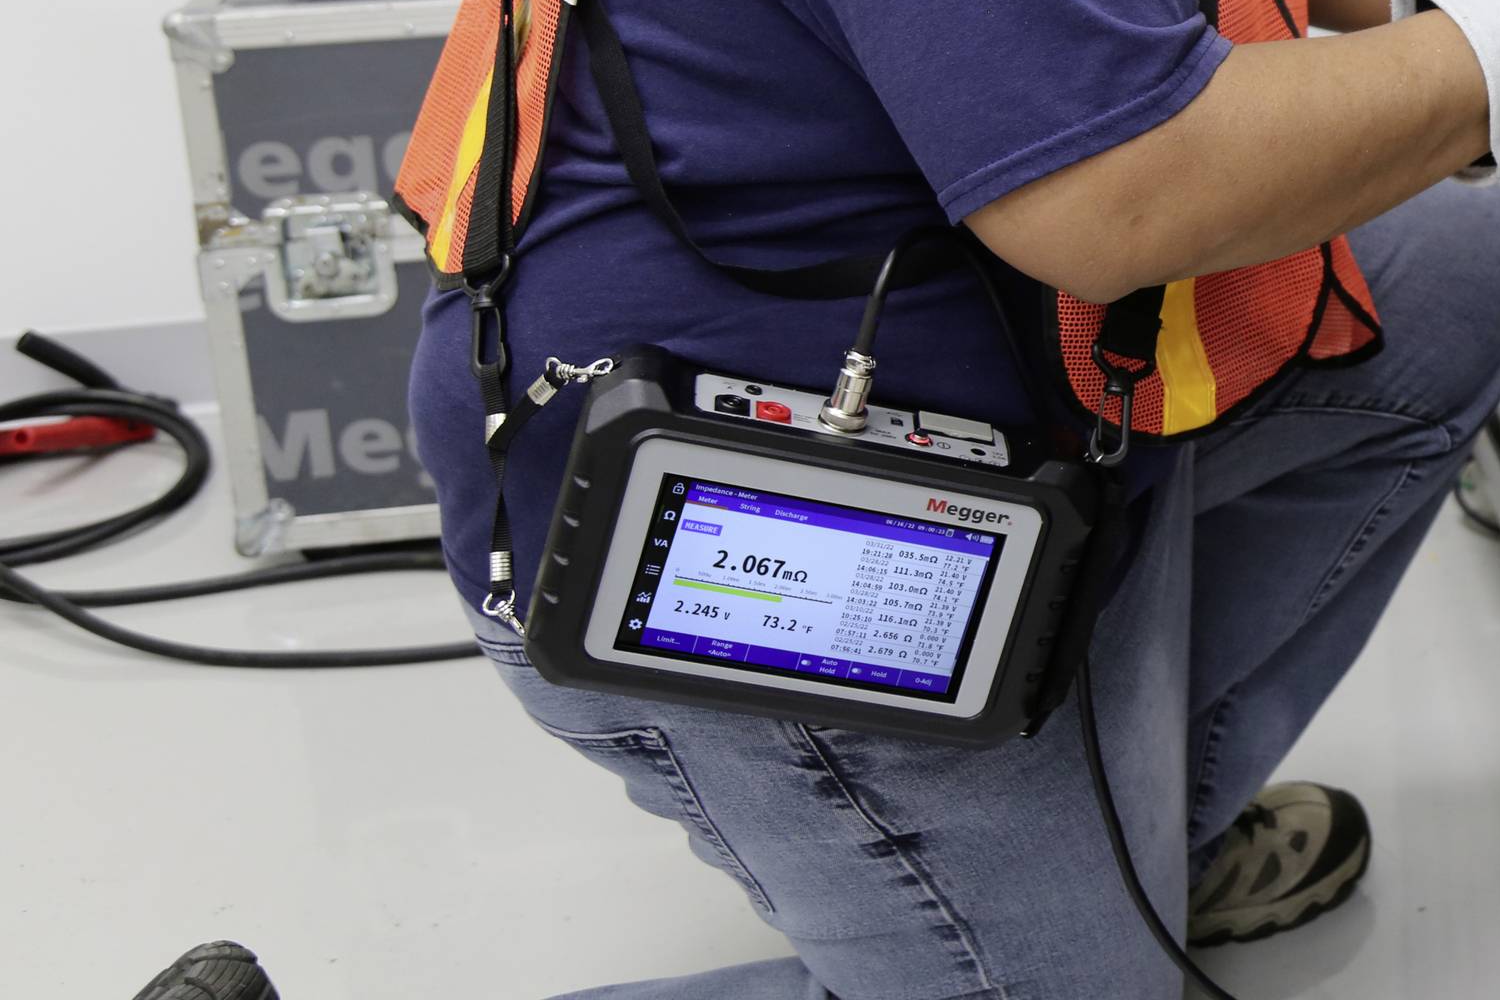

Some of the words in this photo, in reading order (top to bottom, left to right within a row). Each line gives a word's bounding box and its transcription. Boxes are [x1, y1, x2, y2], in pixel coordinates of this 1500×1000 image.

[695, 484, 734, 497] Impedance
[738, 492, 758, 501] Meter
[698, 496, 719, 505] Meter
[739, 503, 761, 513] String
[926, 498, 1010, 524] Megger
[774, 509, 809, 521] Discharge
[685, 521, 719, 534] MEASURE
[653, 538, 670, 548] VA
[674, 600, 720, 619] 2.245
[723, 612, 731, 621] V
[761, 615, 798, 632] 73.2
[801, 625, 814, 634] °F
[873, 630, 899, 641] 2.656
[711, 640, 734, 650] Range
[707, 649, 732, 658] <Auto>
[868, 646, 894, 656] 2.679
[822, 659, 839, 667] Auto
[819, 667, 836, 675] Hold
[870, 670, 888, 679] Hold
